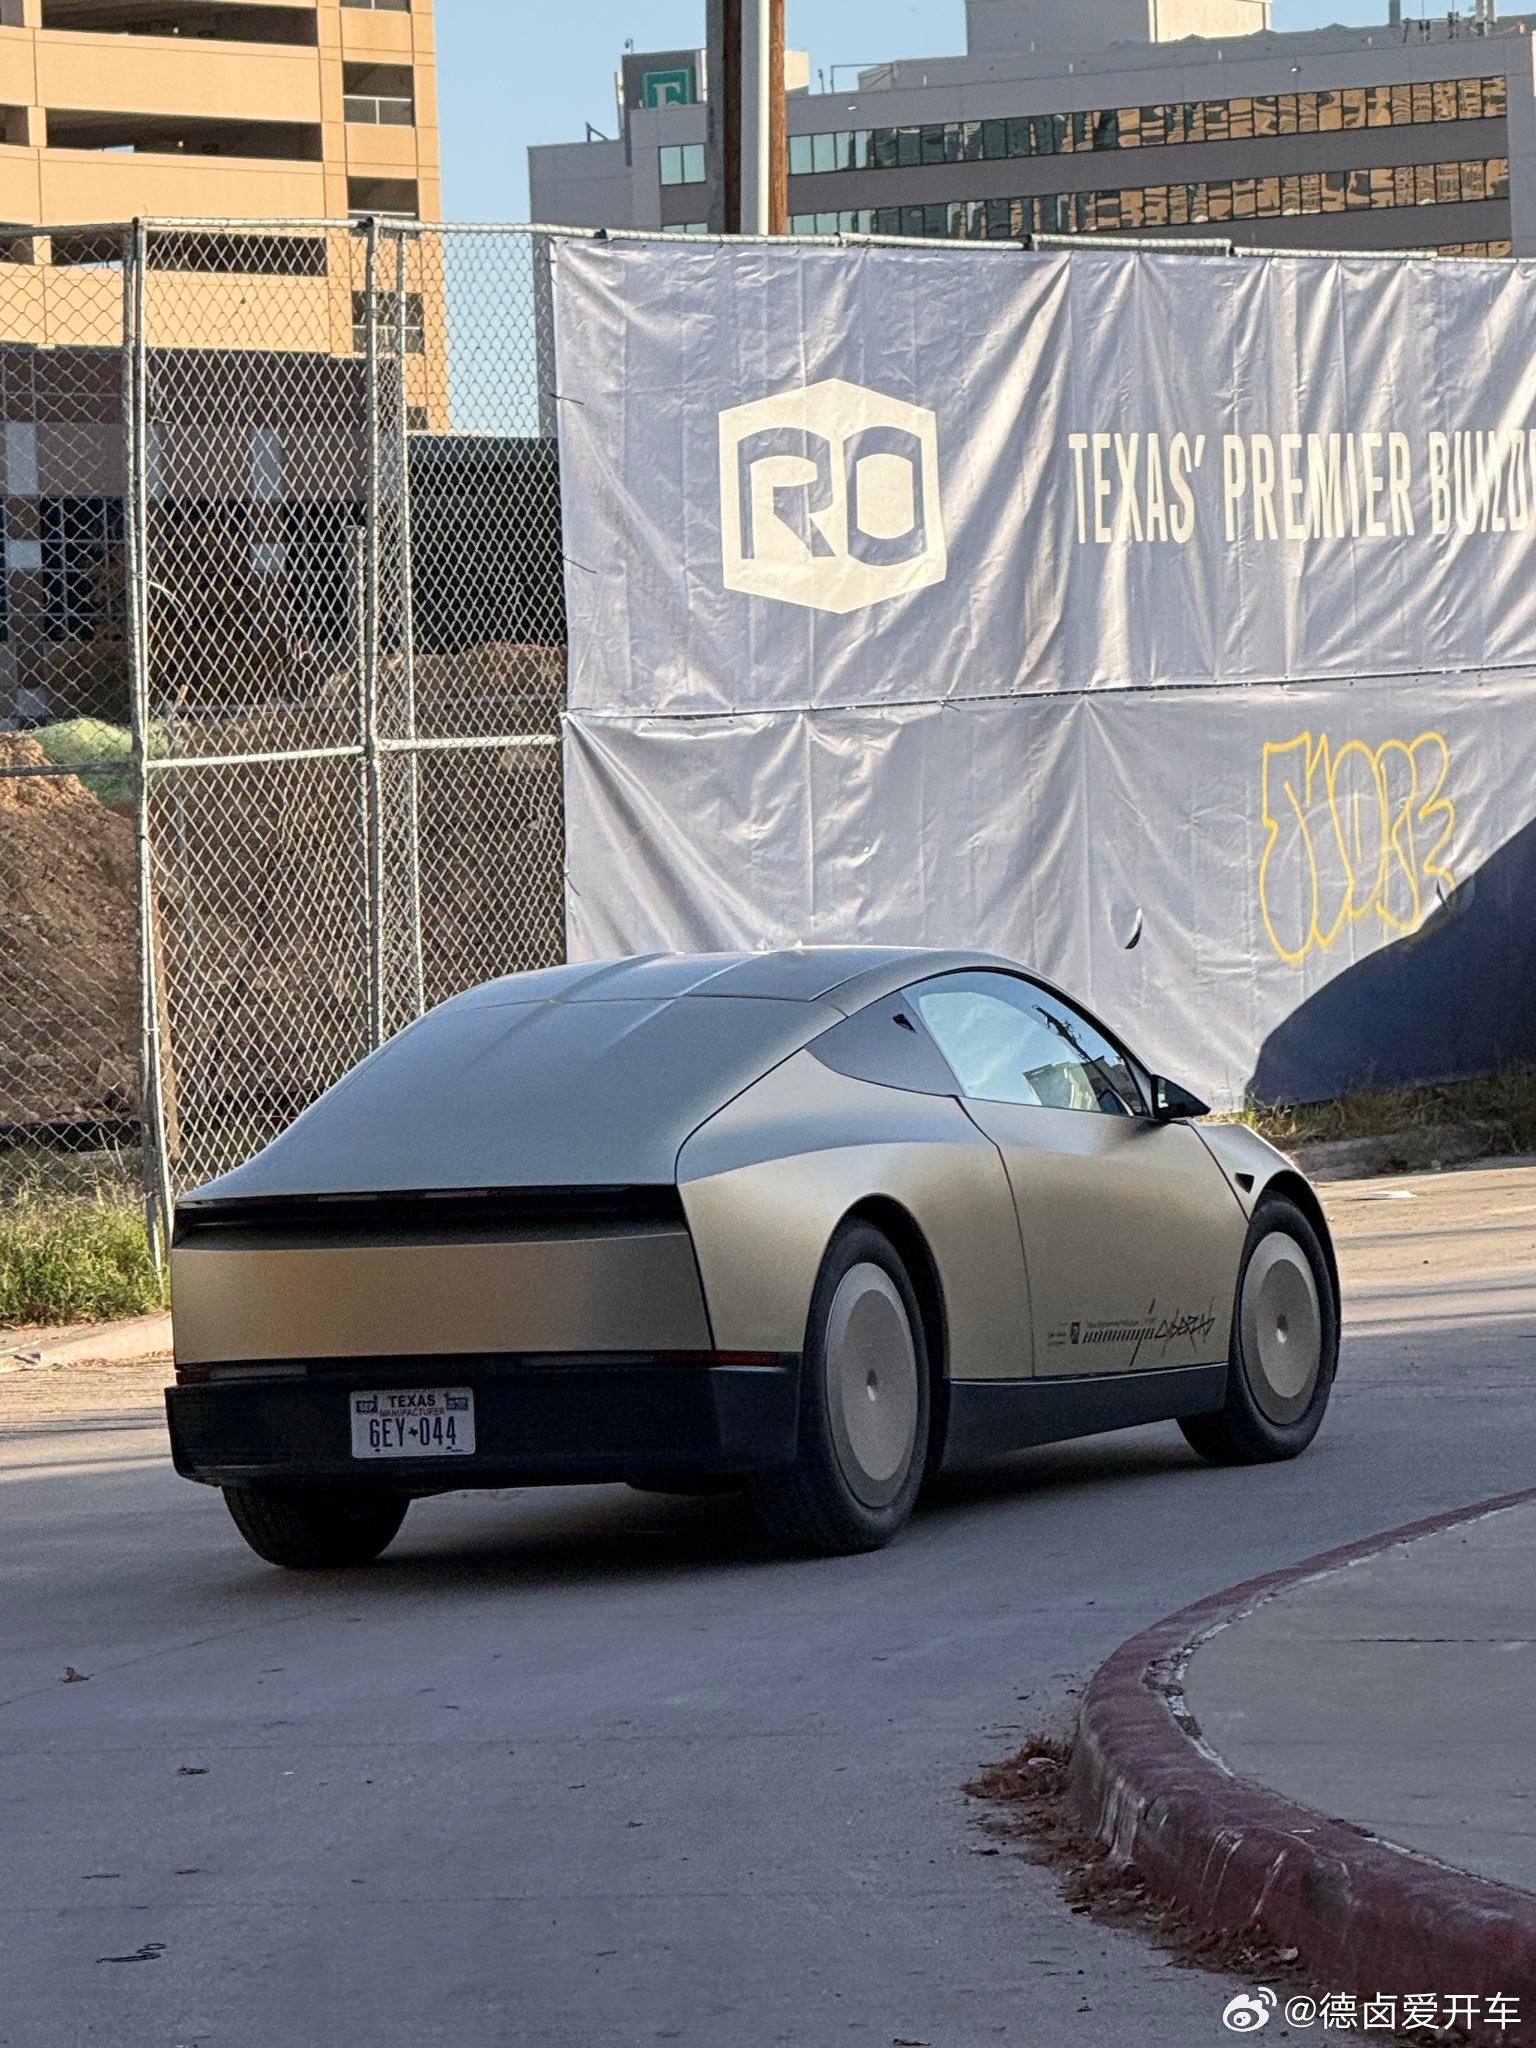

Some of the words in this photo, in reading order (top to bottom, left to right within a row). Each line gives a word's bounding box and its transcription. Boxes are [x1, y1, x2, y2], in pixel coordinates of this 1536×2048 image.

[1223, 432, 1415, 541] PREMIER
[1429, 429, 1536, 535] BUILD
[388, 1394, 436, 1407] TEXAS
[379, 1407, 445, 1417] MANUFACTURER
